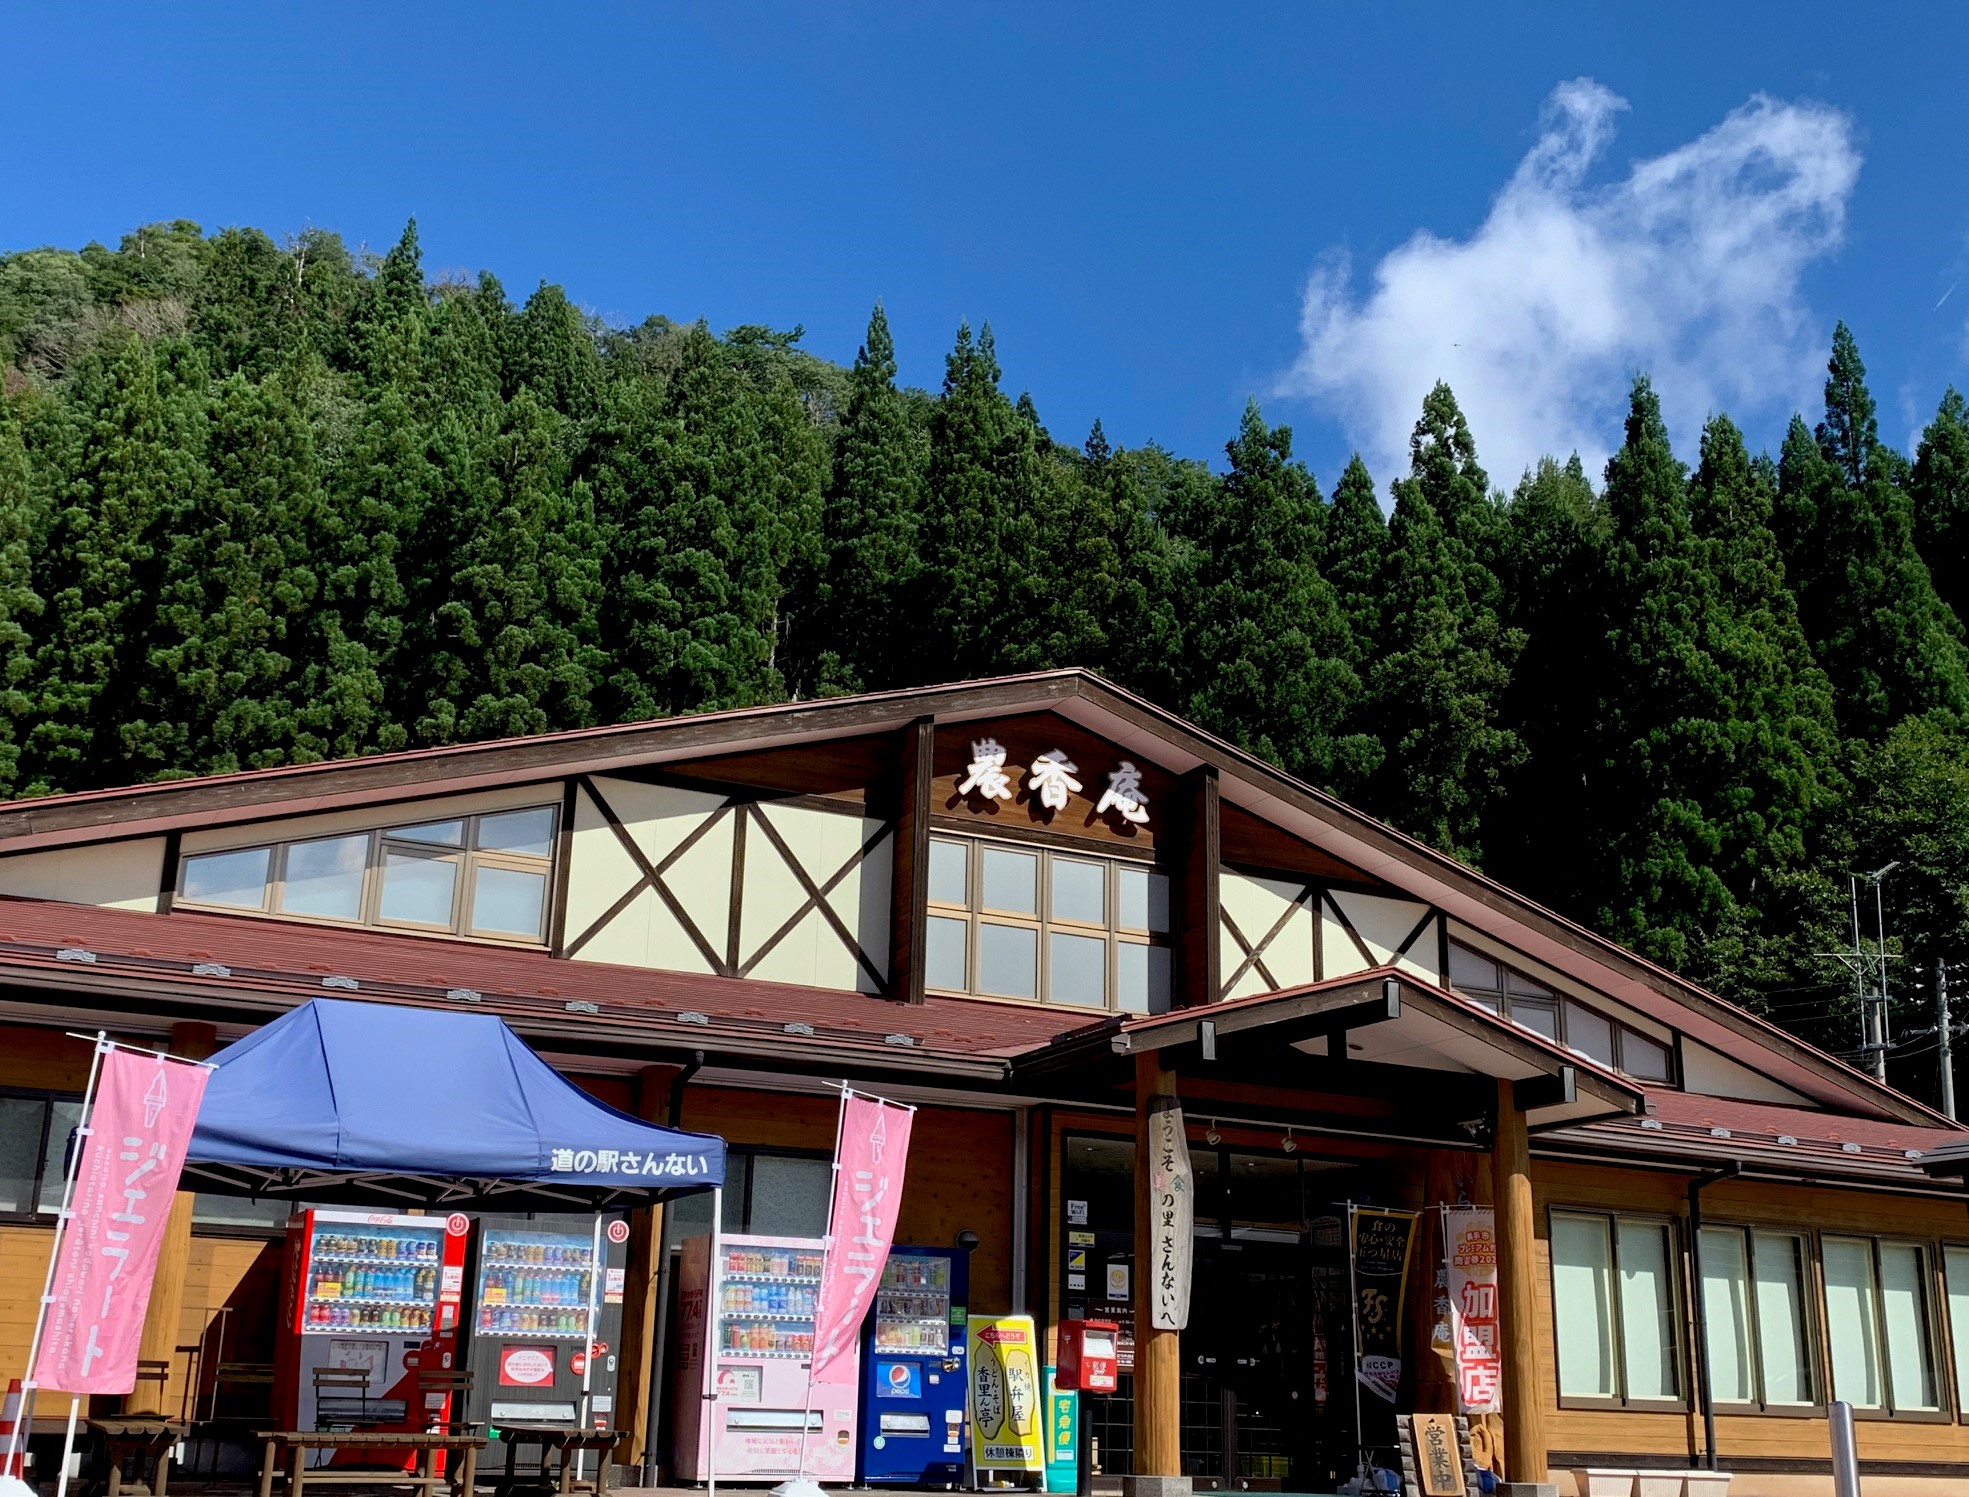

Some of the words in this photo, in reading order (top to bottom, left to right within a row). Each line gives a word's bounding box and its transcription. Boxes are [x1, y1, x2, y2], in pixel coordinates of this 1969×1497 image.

[958, 737, 1150, 823] 農香庵
[551, 1148, 708, 1176] 道の駅さんない
[81, 1136, 167, 1378] ジェラート
[1371, 1219, 1396, 1233] 食の
[816, 1170, 888, 1369] ジェラート
[1160, 1236, 1176, 1326] さんないへ
[1461, 1281, 1500, 1406] 加盟店
[890, 1387, 910, 1396] pepsi
[990, 1356, 1002, 1415] うどん・そば
[1008, 1367, 1027, 1422] 駅弁屋
[985, 1447, 1033, 1459] 休憩棟隣り
[1425, 1425, 1453, 1491] 営業中
